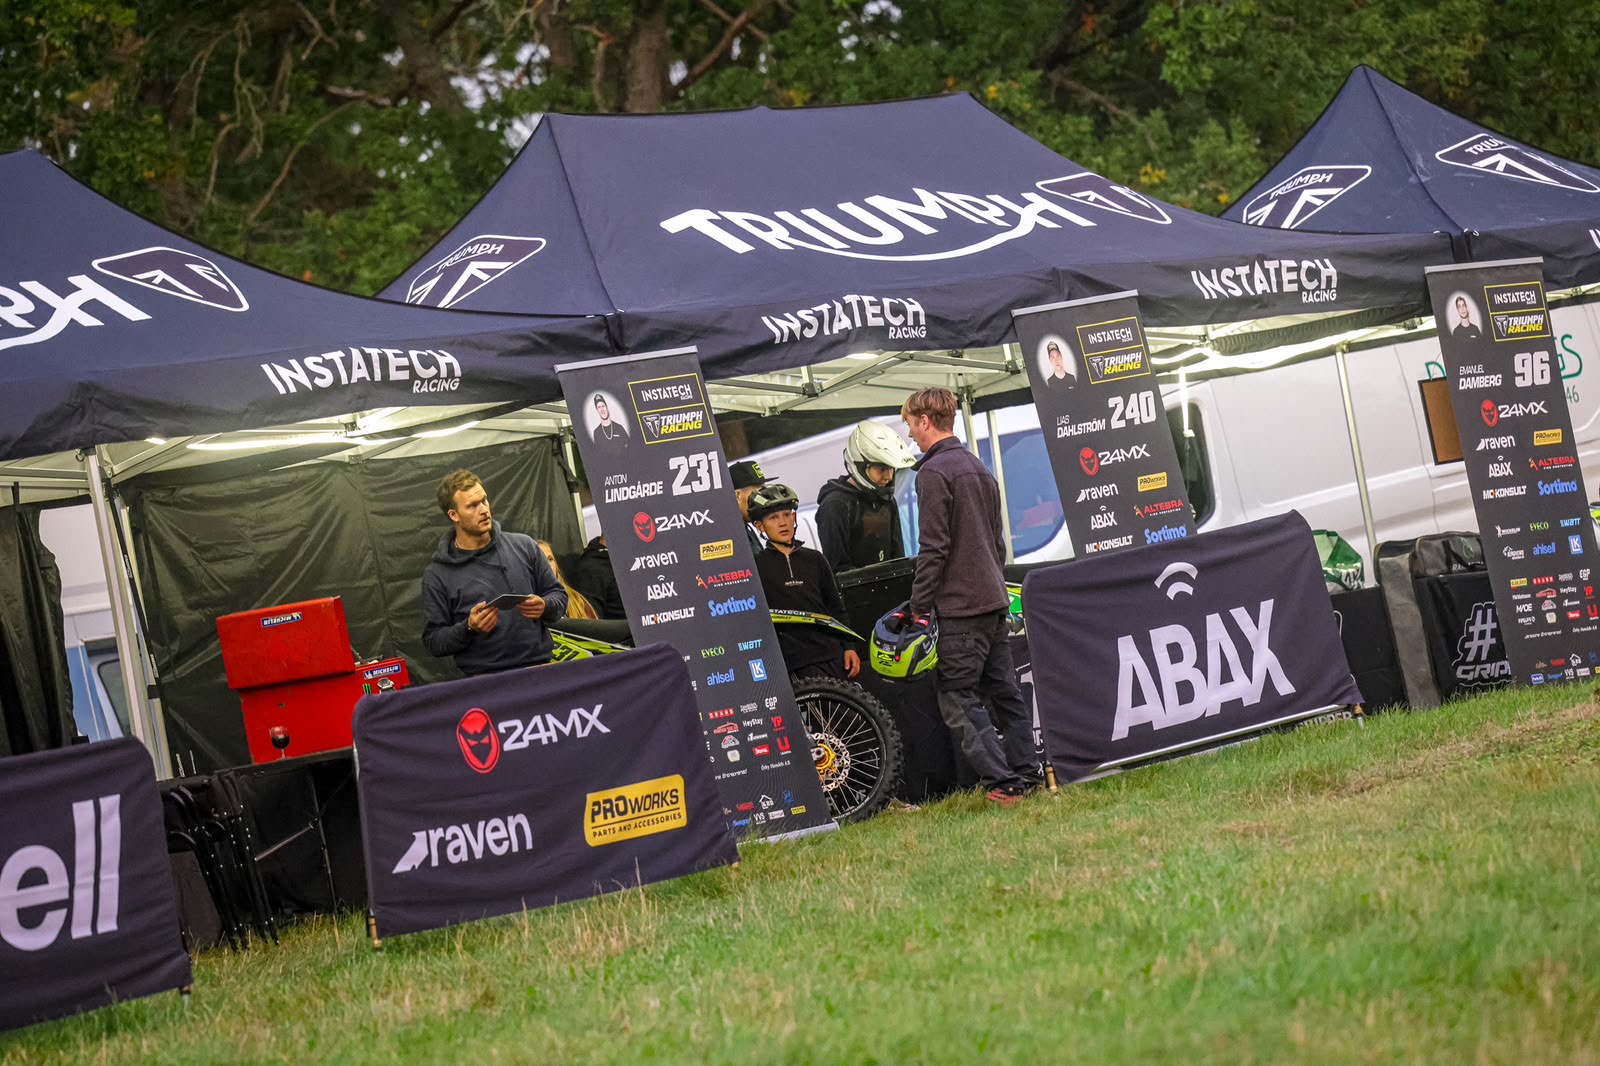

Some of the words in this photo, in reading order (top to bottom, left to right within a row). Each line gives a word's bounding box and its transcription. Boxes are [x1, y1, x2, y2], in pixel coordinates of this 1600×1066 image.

[1269, 173, 1334, 200] TRIUMPH
[660, 187, 1097, 261] TRIUMPH
[436, 243, 505, 273] TRIUMPH
[1191, 258, 1338, 300] INSTATECH
[1302, 287, 1338, 303] RACING
[1494, 290, 1537, 305] INSTATECH
[761, 294, 927, 346] INSTATECH
[1508, 314, 1544, 326] TRIUMPH
[1508, 323, 1543, 334] RACING
[888, 324, 927, 340] RACING
[1088, 328, 1132, 345] INSTATECH
[1103, 352, 1142, 367] TRIUMPH
[1103, 361, 1141, 375] RACING
[261, 347, 462, 396] INSTATECH
[1459, 364, 1485, 376] EMANUEL
[1514, 350, 1551, 388] 96
[412, 376, 461, 394] RACING
[1459, 374, 1502, 391] DAMBERG
[641, 384, 693, 402] INSTATECH
[660, 410, 703, 426] TRIUMPH
[1108, 390, 1157, 430] 240
[1498, 401, 1548, 418] 24MX
[660, 420, 703, 435] RACING
[1057, 418, 1106, 439] DAHLSTRÖM
[1485, 435, 1516, 450] raven
[1098, 444, 1151, 466] 24MX
[1538, 456, 1576, 466] ALTEBRA
[669, 451, 722, 497] 231
[1488, 462, 1514, 478] ABAX
[604, 473, 628, 487] ANTON
[1538, 479, 1577, 496] Sortimo
[605, 481, 664, 504] LINDGÅRDE
[1086, 483, 1119, 501] raven
[1143, 500, 1184, 514] ALTEBRA
[655, 509, 714, 532] 24MX
[1091, 511, 1118, 530] ABAX
[1144, 524, 1187, 545] Sortimo
[1532, 541, 1556, 556] ahlsell
[640, 551, 679, 570] raven
[708, 568, 753, 585] ALTEBRA
[647, 581, 678, 602] ABAX
[708, 594, 757, 618] Sortimo
[372, 665, 400, 677] MICHELIN
[707, 668, 735, 686] ahlsell
[1111, 598, 1296, 741] ABAX
[1456, 660, 1512, 680] GRIP
[499, 704, 612, 752] 24MX
[591, 788, 679, 824] PROWORKS
[592, 827, 616, 838] PARTS
[618, 824, 632, 833] AND
[633, 812, 682, 829] ACCESSORIES
[428, 812, 533, 868] raven
